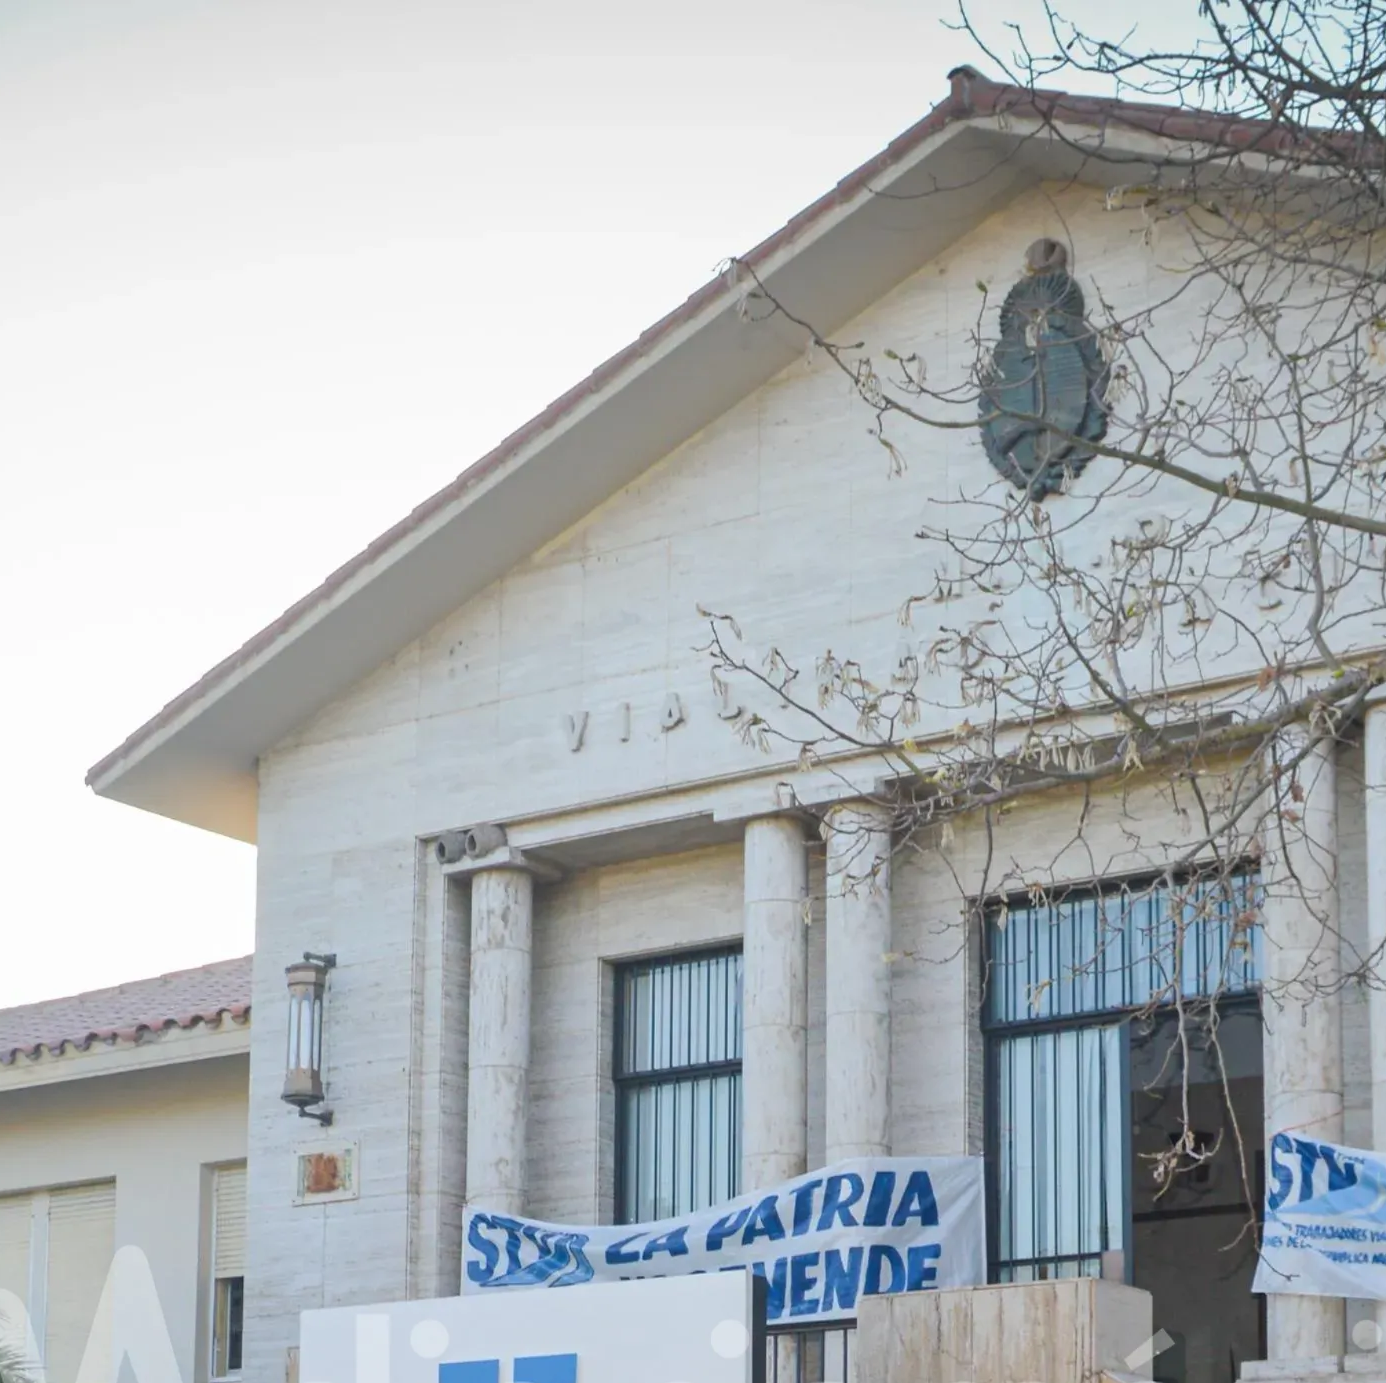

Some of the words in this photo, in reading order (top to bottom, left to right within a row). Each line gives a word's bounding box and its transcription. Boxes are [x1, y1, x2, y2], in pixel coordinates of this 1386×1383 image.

[605, 1224, 690, 1265] LA
[705, 1169, 941, 1252] PATRIA
[752, 1243, 942, 1321] VENDE
